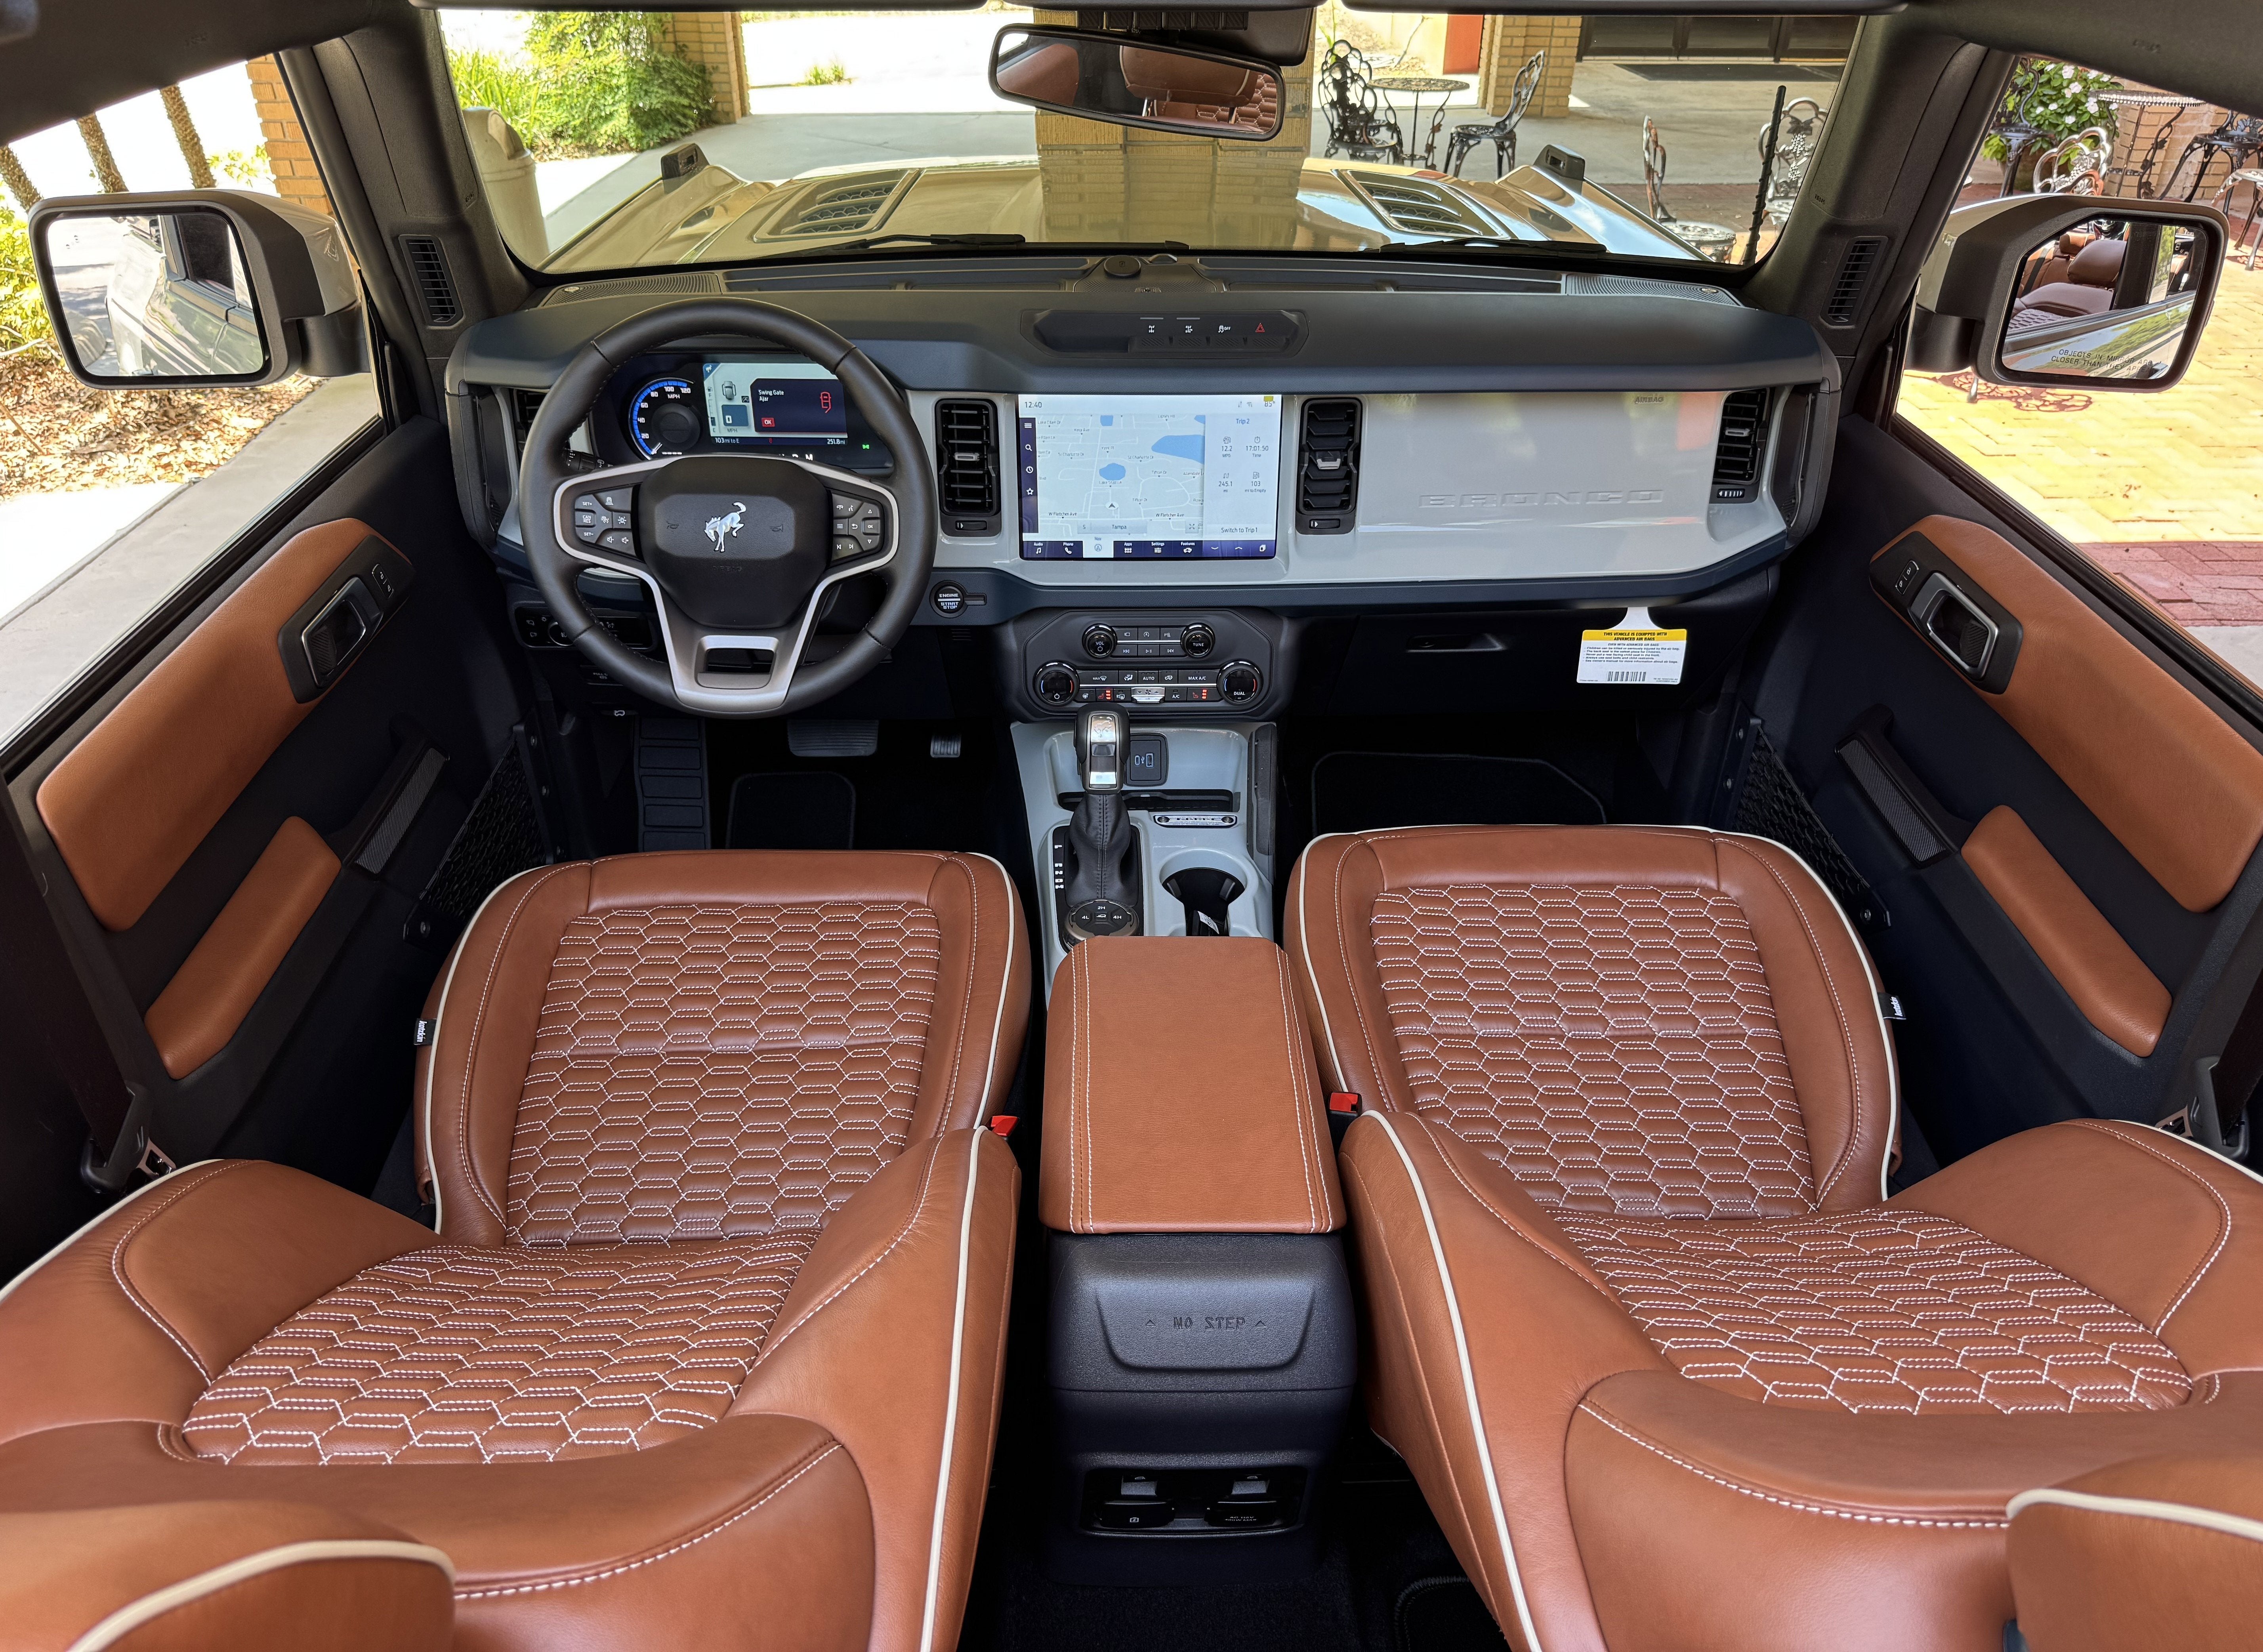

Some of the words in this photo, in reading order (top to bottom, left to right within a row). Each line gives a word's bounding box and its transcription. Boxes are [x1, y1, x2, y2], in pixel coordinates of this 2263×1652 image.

[2051, 356, 2079, 364] CLOSER
[2059, 349, 2091, 358] OBJECTS
[2107, 355, 2135, 363] MIRROR
[725, 415, 732, 423] 0
[1418, 490, 1664, 508] BRONCO
[417, 1020, 427, 1042] katzkin
[1173, 1317, 1193, 1330] NO
[1205, 1317, 1246, 1330] STEP
